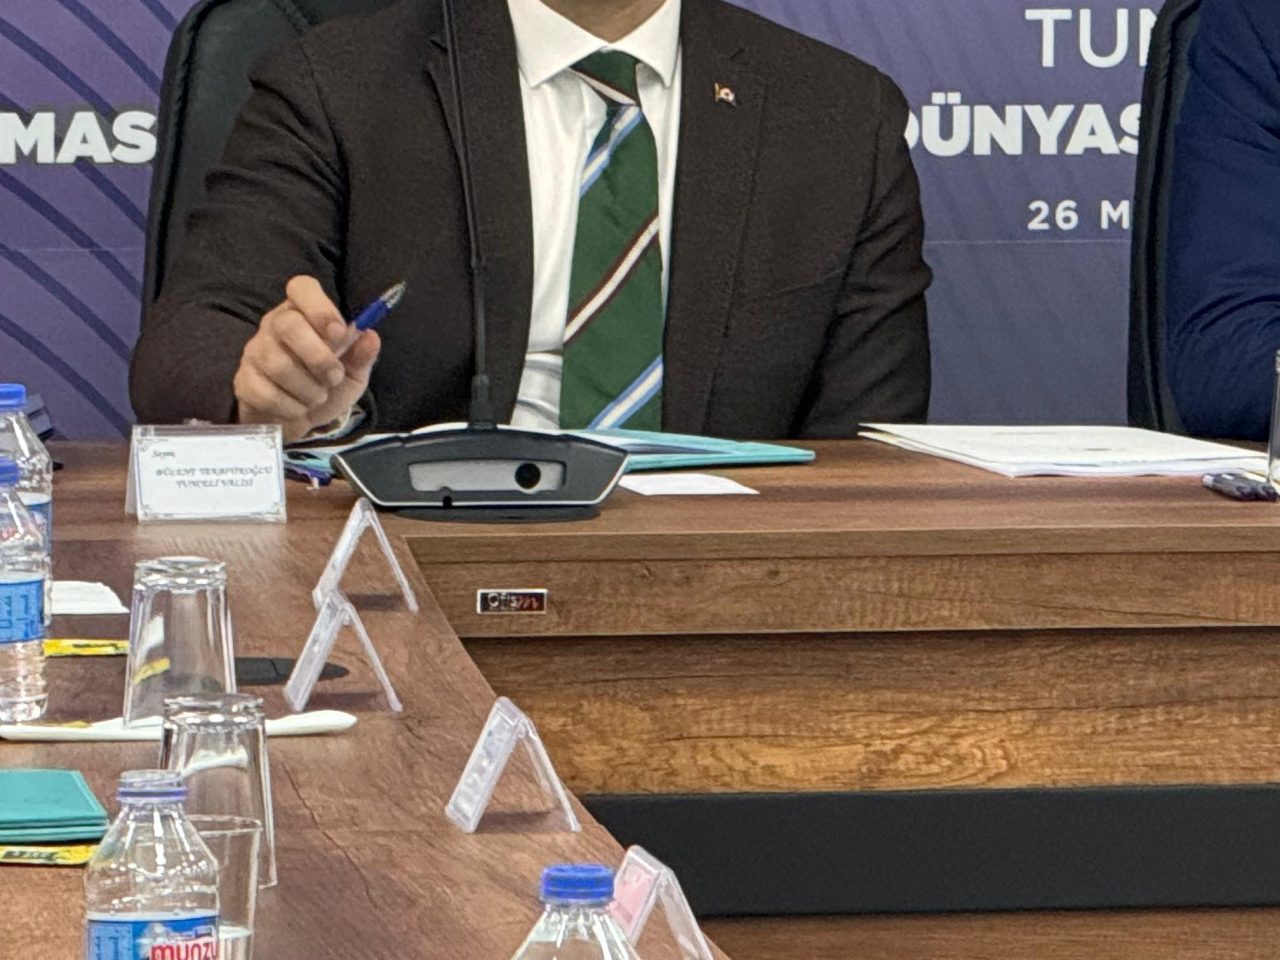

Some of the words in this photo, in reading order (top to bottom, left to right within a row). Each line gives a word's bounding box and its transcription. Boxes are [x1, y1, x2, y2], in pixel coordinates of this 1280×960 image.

[0, 110, 157, 164] MAS
[1027, 200, 1078, 230] 26
[1101, 200, 1130, 230] M
